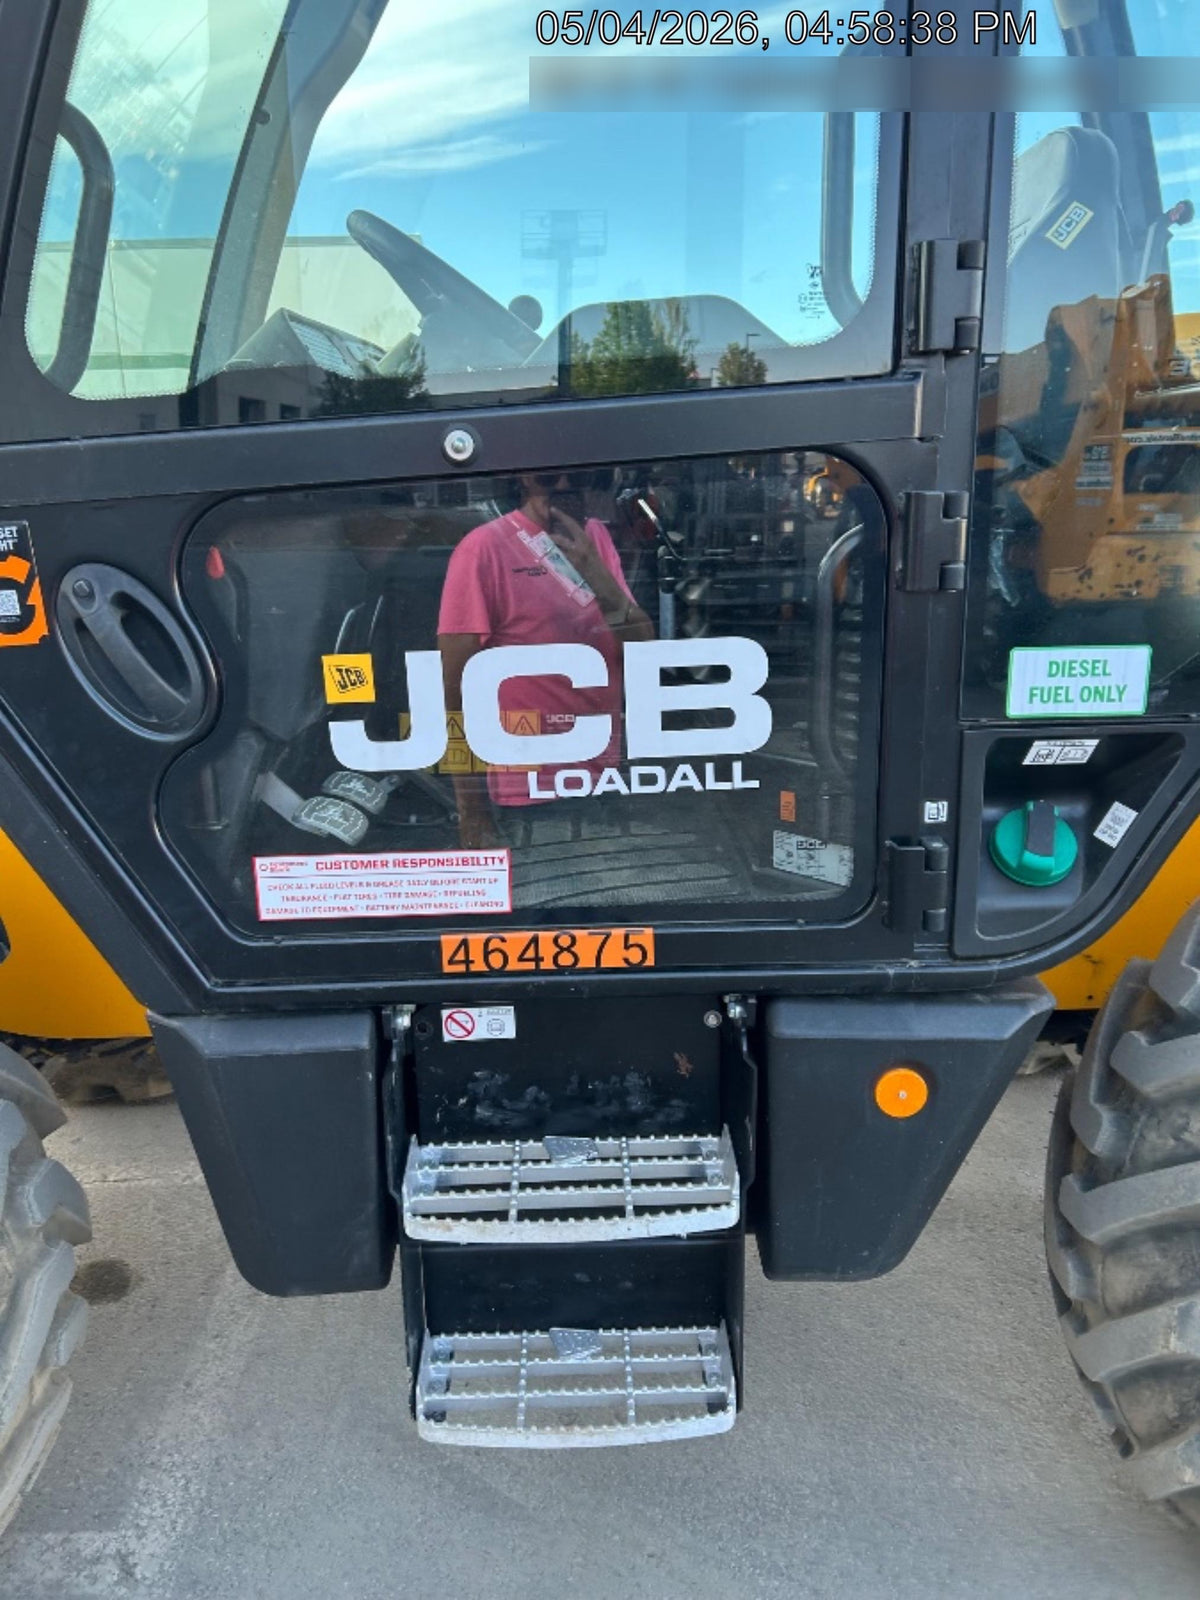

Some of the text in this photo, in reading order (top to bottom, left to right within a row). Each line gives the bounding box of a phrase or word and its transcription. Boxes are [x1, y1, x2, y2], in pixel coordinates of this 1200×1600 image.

[1053, 206, 1089, 242] JCB
[336, 668, 364, 690] JCB
[1047, 659, 1112, 678] DIESEL
[329, 635, 772, 772] JCB
[1028, 684, 1127, 704] FUEL ONLY
[527, 760, 760, 799] LOADALL
[315, 860, 389, 871] CUSTOMER
[392, 856, 503, 869] RESPONSIBILITY
[447, 930, 648, 972] 464875
